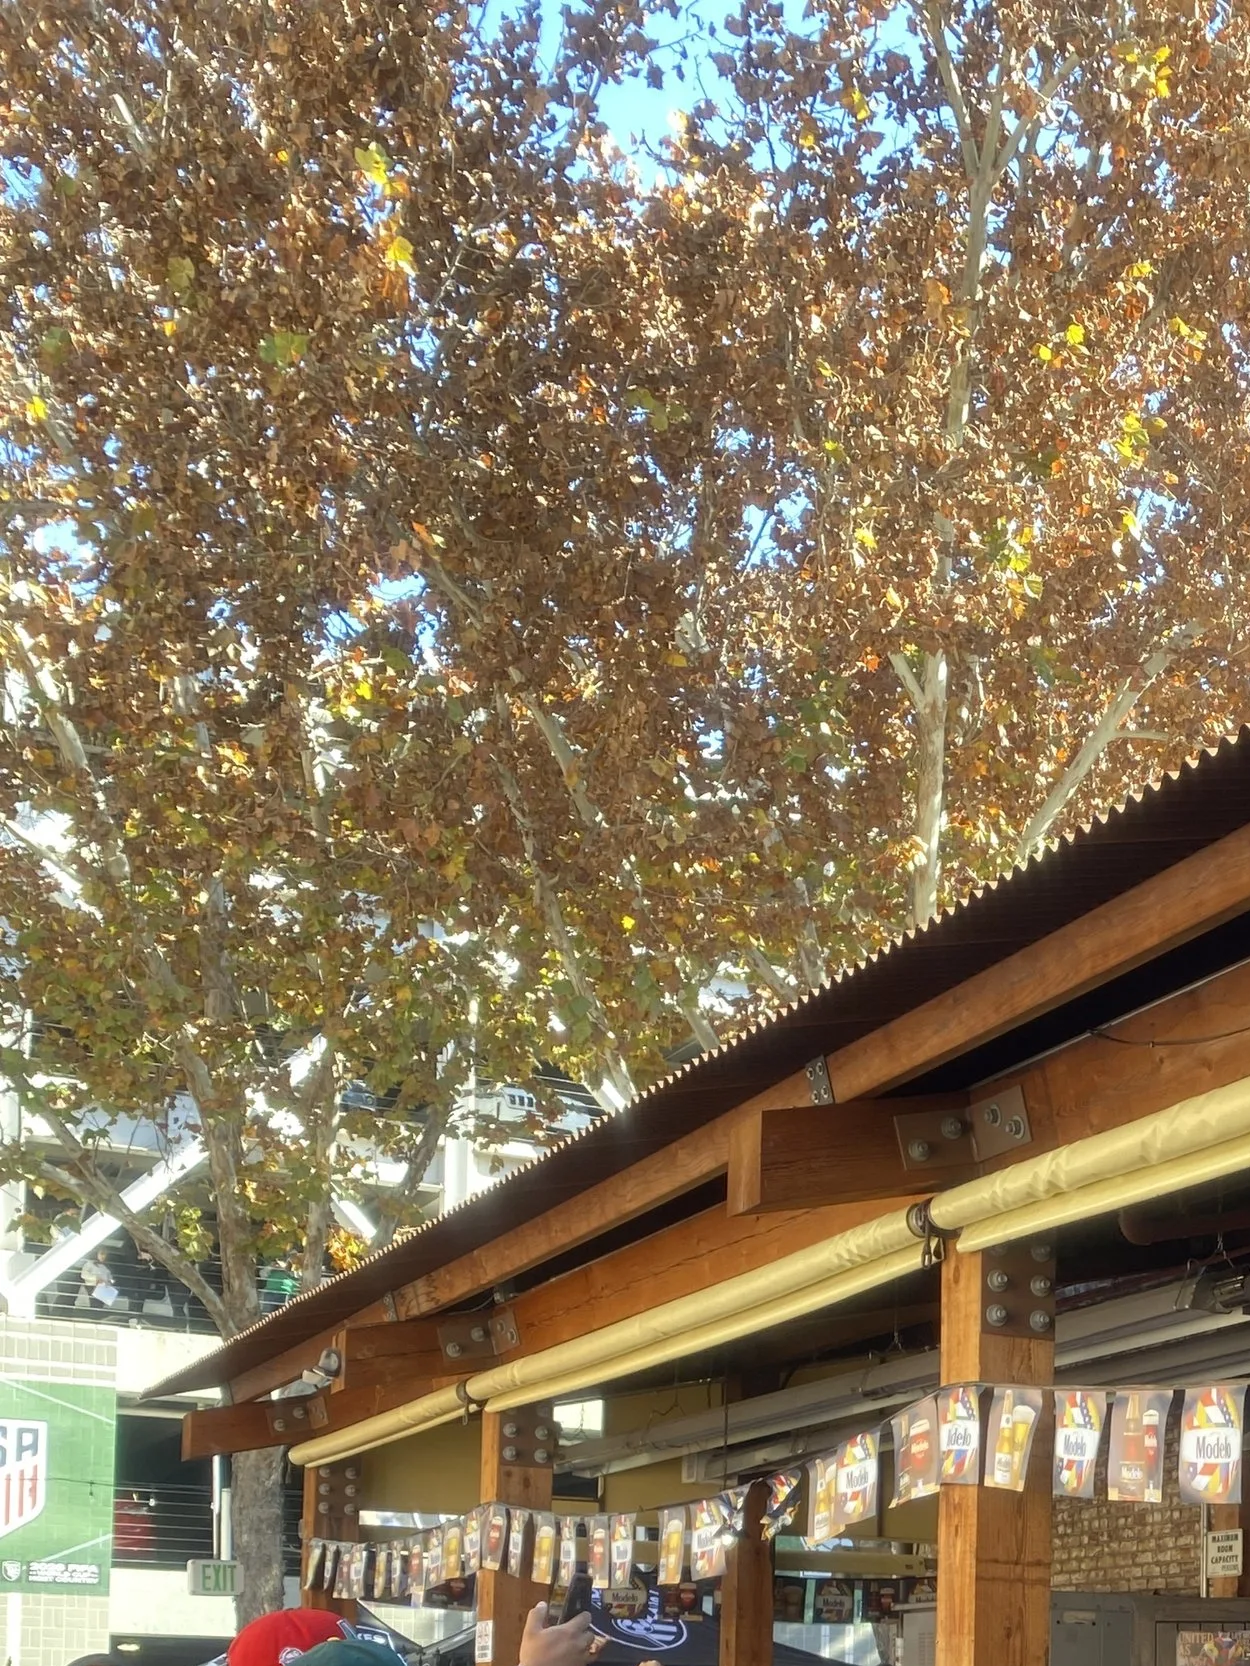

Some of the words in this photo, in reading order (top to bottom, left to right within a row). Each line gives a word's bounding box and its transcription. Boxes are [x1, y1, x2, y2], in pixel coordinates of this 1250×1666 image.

[1063, 1434, 1087, 1457] Modelo
[1195, 1436, 1232, 1460] Modelo
[846, 1469, 869, 1489] Modelo
[1211, 1555, 1239, 1565] CAPACITY
[202, 1564, 237, 1592] EXIT
